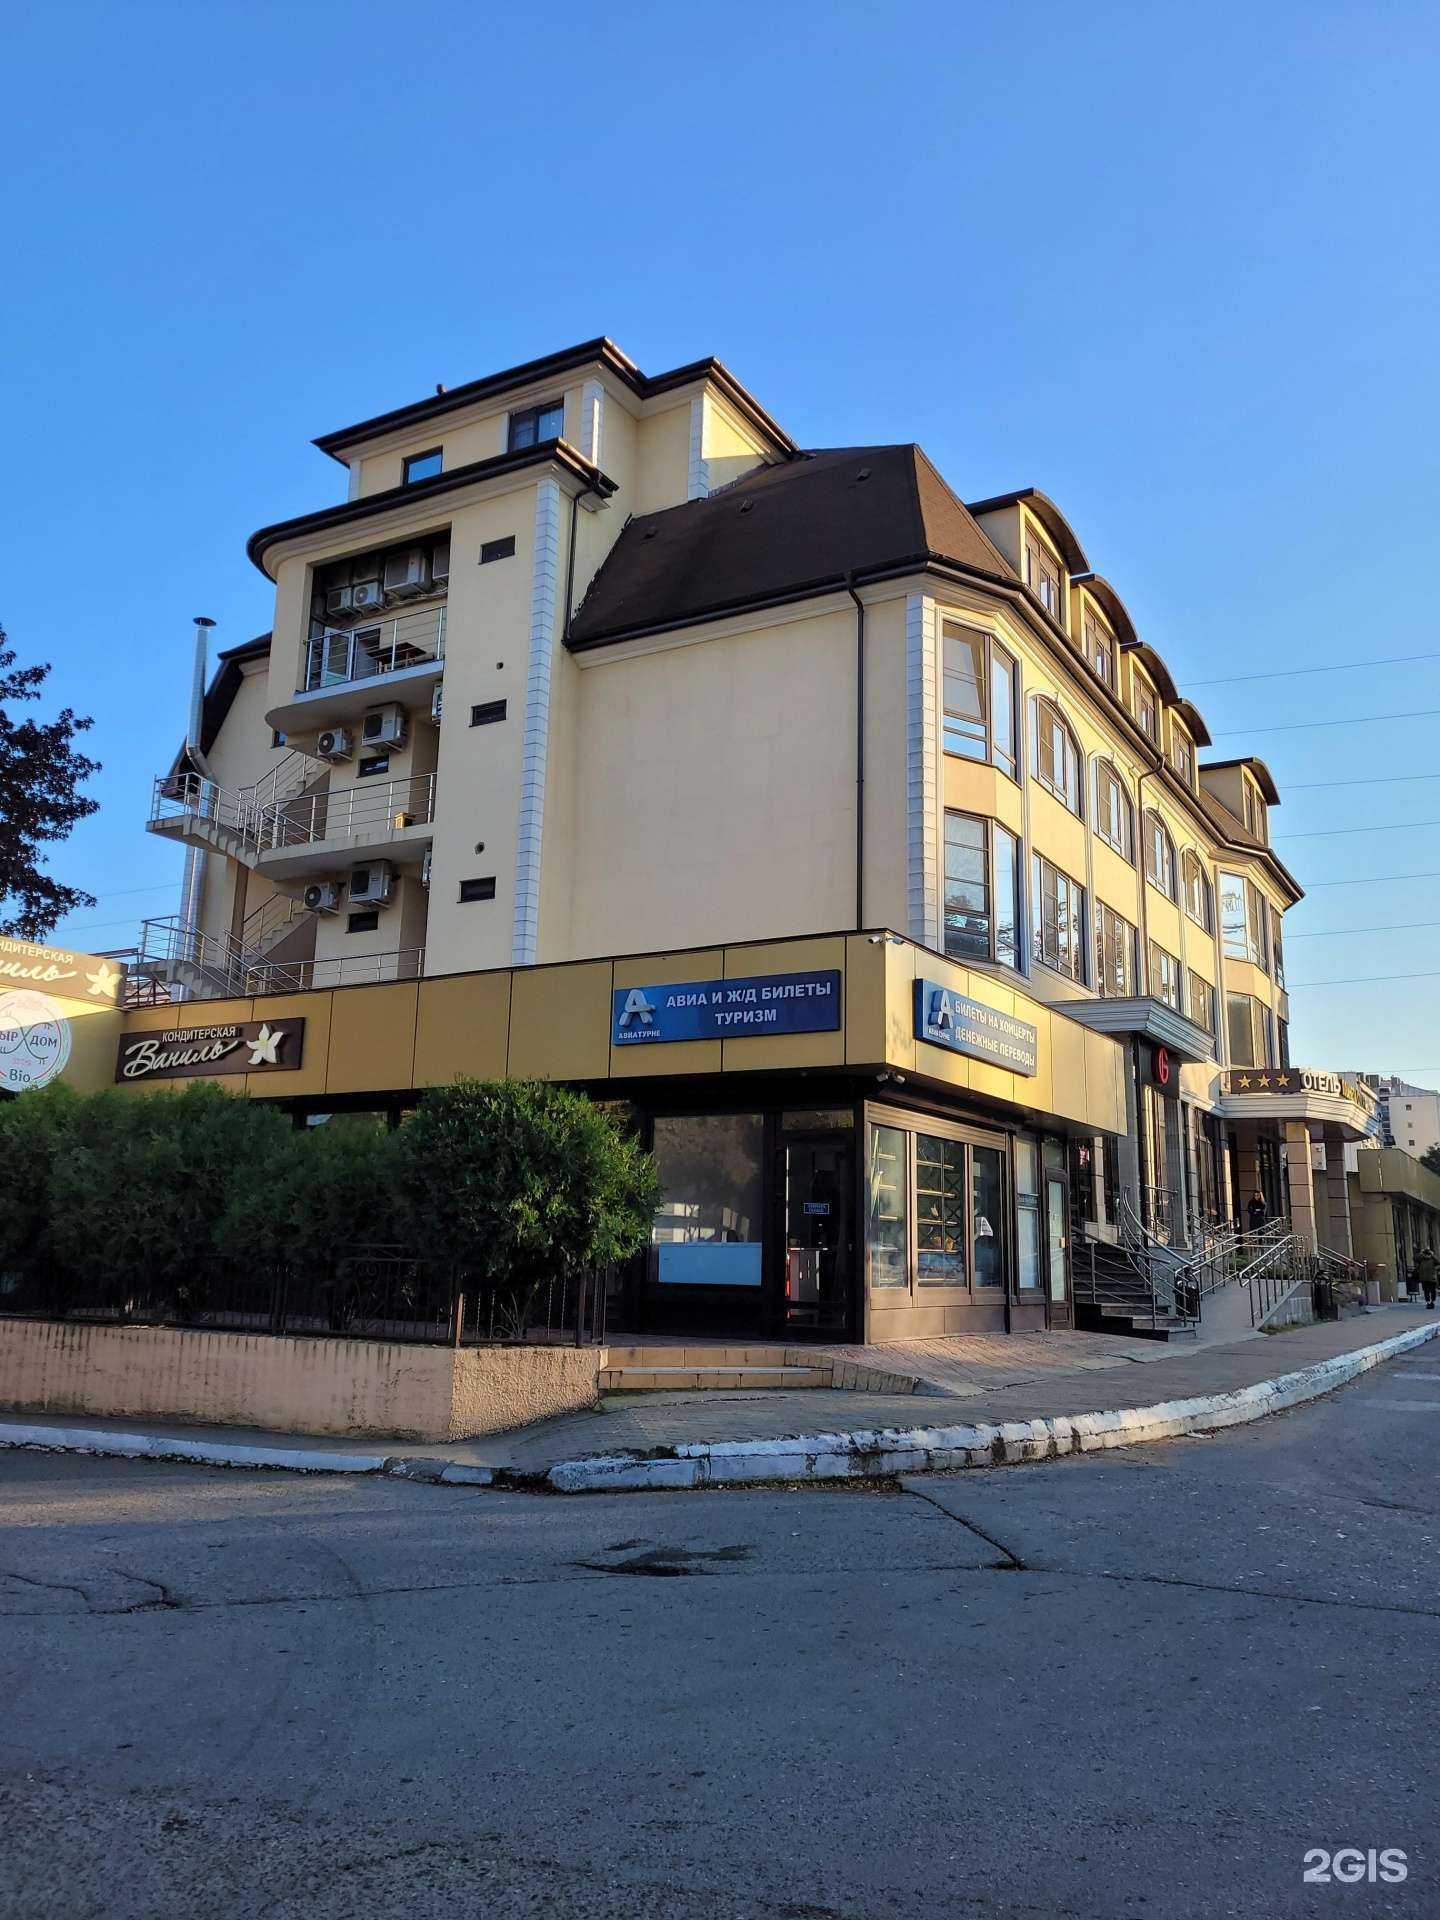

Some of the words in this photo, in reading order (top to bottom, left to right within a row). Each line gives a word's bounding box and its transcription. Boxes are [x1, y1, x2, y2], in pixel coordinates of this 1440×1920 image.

[666, 991, 707, 1008] АВИА
[712, 991, 722, 1004] И
[727, 988, 757, 1004] Ж/Д
[762, 982, 831, 999] БИЛЕТЫ
[715, 1009, 777, 1025] ТУРИЗМ
[955, 1001, 987, 1025] БИЛЕТЫ
[988, 1014, 999, 1029] НА
[999, 1018, 1035, 1043] КОНЦЕРТЫ
[162, 1026, 236, 1043] КОНДИТЕРСКАЯ
[123, 1040, 238, 1077] Ваниль
[955, 1026, 999, 1053] ДЕНЕЖНЫЕ
[999, 1043, 1035, 1068] ПЕРЕВОДЫ
[9, 1068, 31, 1082] Bio
[1303, 1072, 1341, 1094] ОТЕЛЬ
